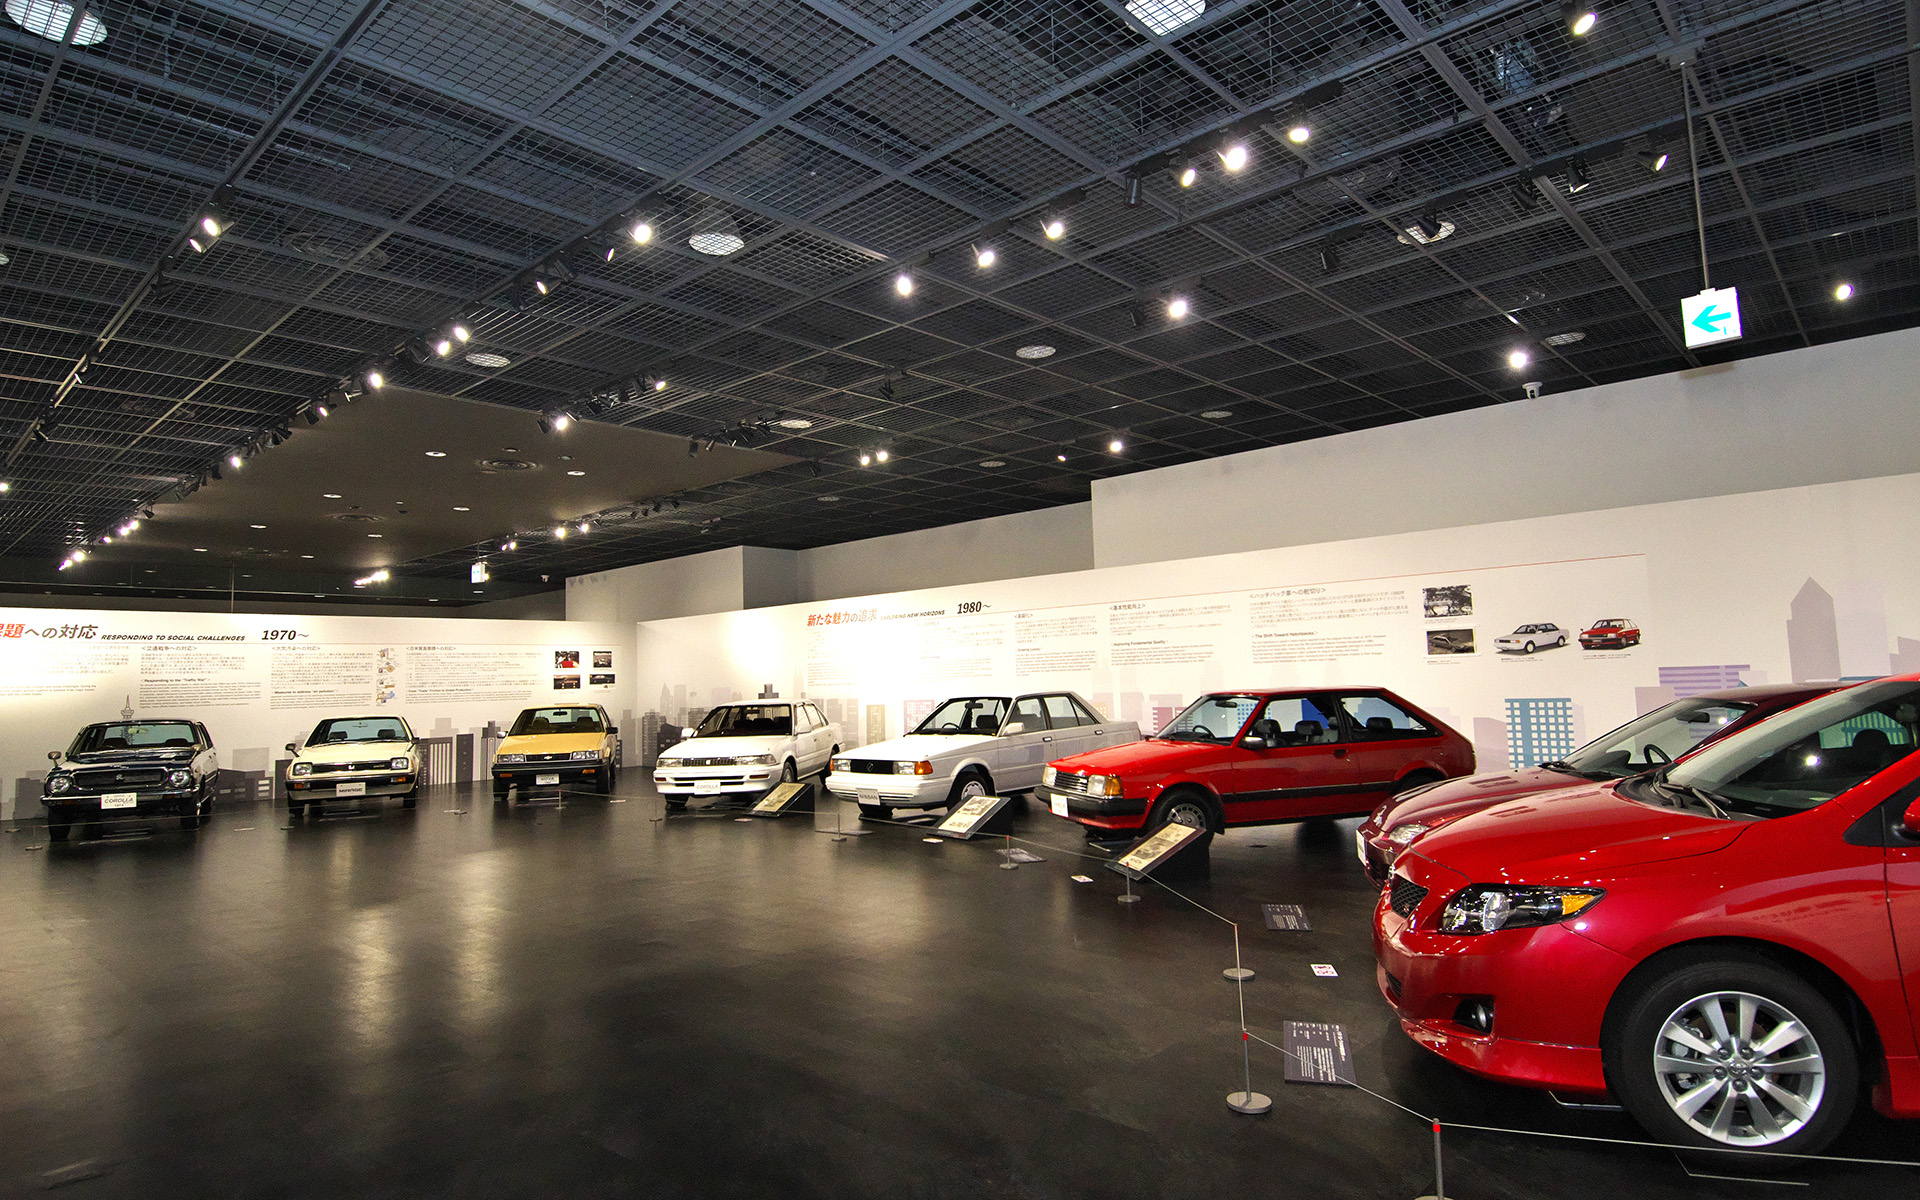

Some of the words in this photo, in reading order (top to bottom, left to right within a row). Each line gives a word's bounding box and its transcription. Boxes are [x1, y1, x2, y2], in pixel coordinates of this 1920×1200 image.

[807, 608, 878, 627] 新たな魅力の追求
[919, 609, 946, 617] HORIZONS
